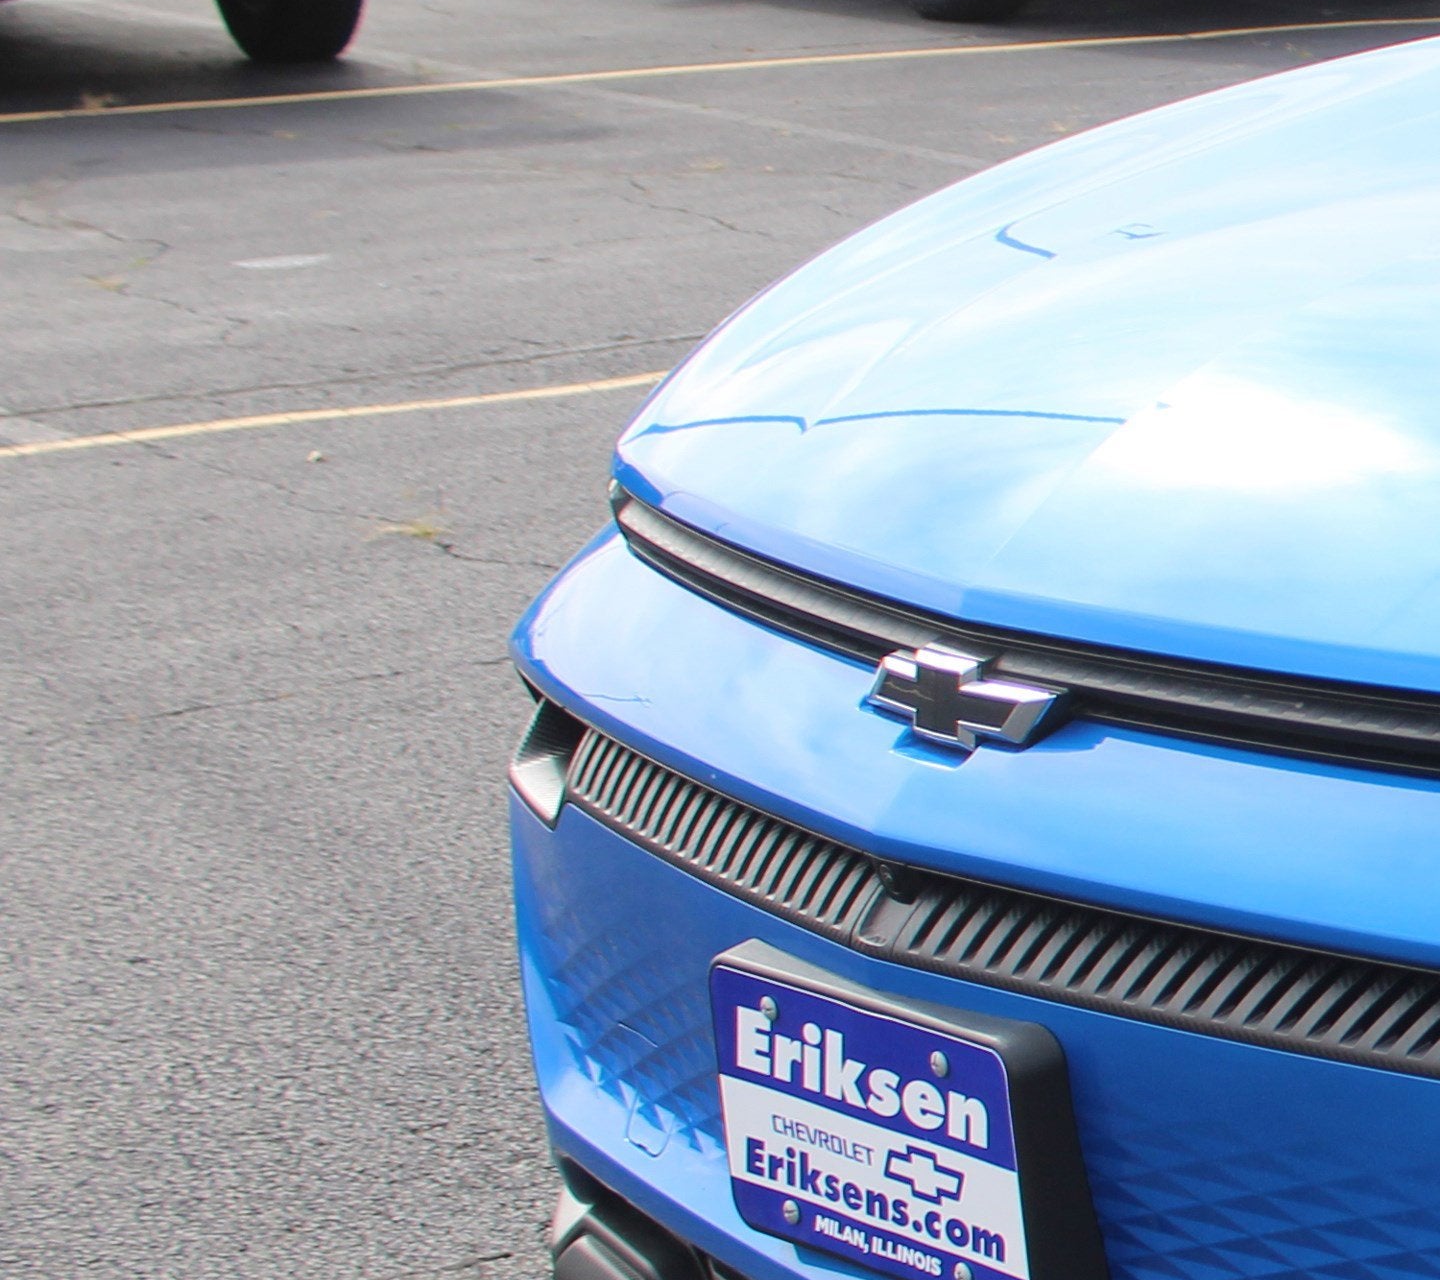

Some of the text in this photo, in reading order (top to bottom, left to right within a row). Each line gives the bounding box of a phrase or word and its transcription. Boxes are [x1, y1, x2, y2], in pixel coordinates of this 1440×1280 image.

[735, 1004, 989, 1150] Eriksen
[771, 1113, 875, 1167] CHEVROLET
[745, 1136, 1007, 1264] Eriksens.com
[814, 1213, 942, 1277] MILAN, ILLINOIS
